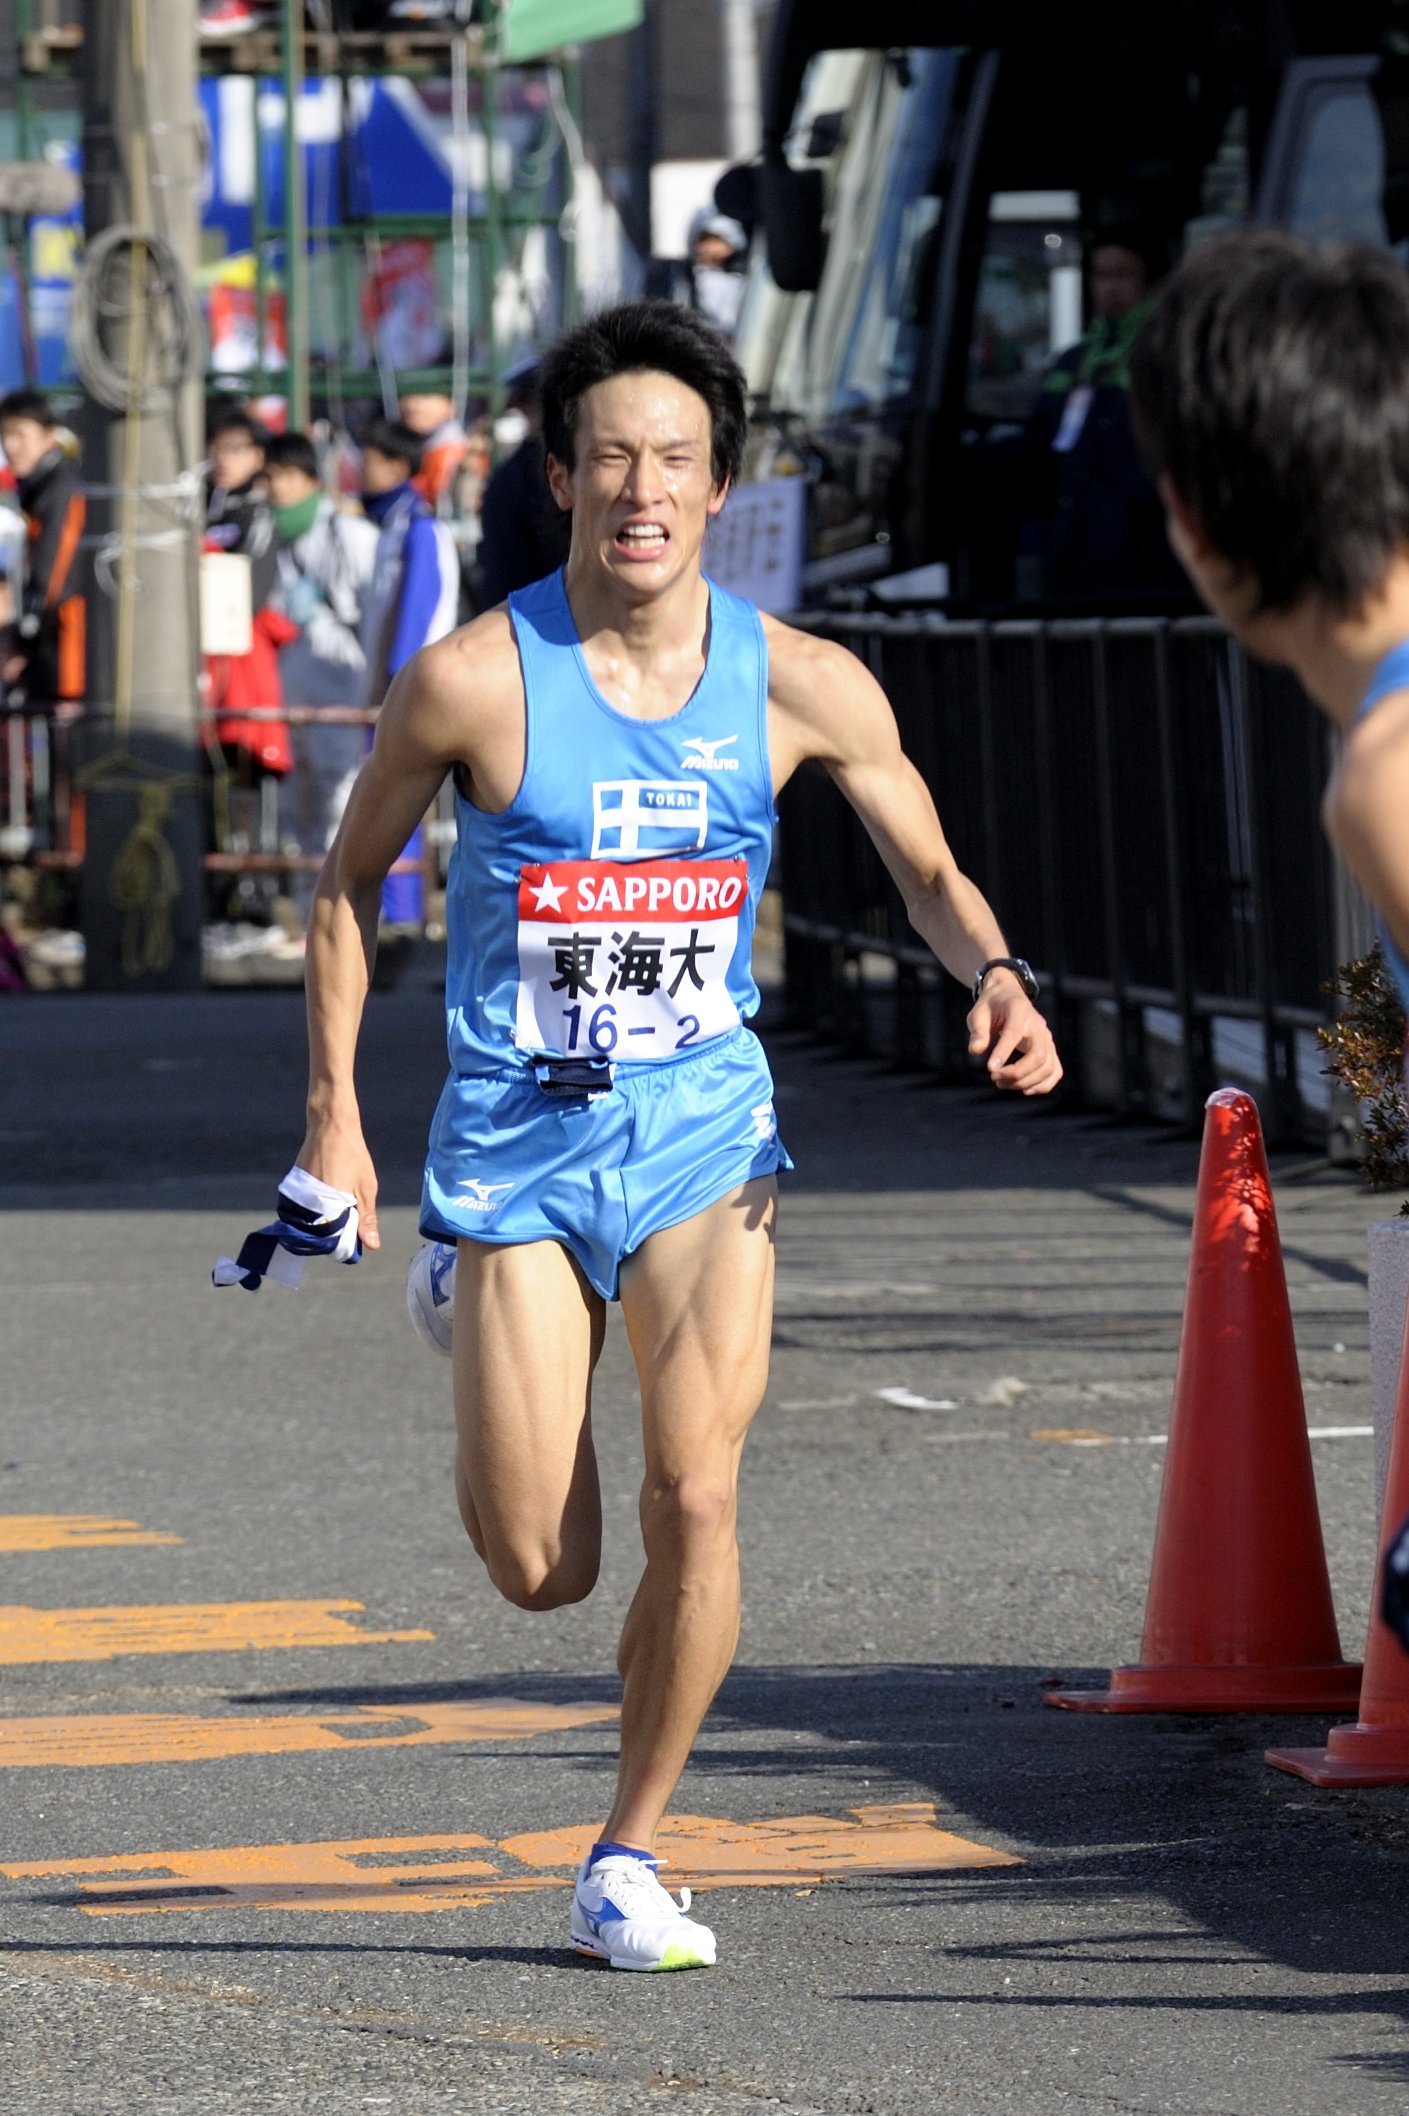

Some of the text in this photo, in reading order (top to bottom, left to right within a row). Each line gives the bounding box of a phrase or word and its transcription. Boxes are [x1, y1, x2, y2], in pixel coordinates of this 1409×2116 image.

[646, 792, 692, 807] TOKAI
[577, 875, 742, 912] SAPPORO
[547, 928, 715, 1000] 東海大
